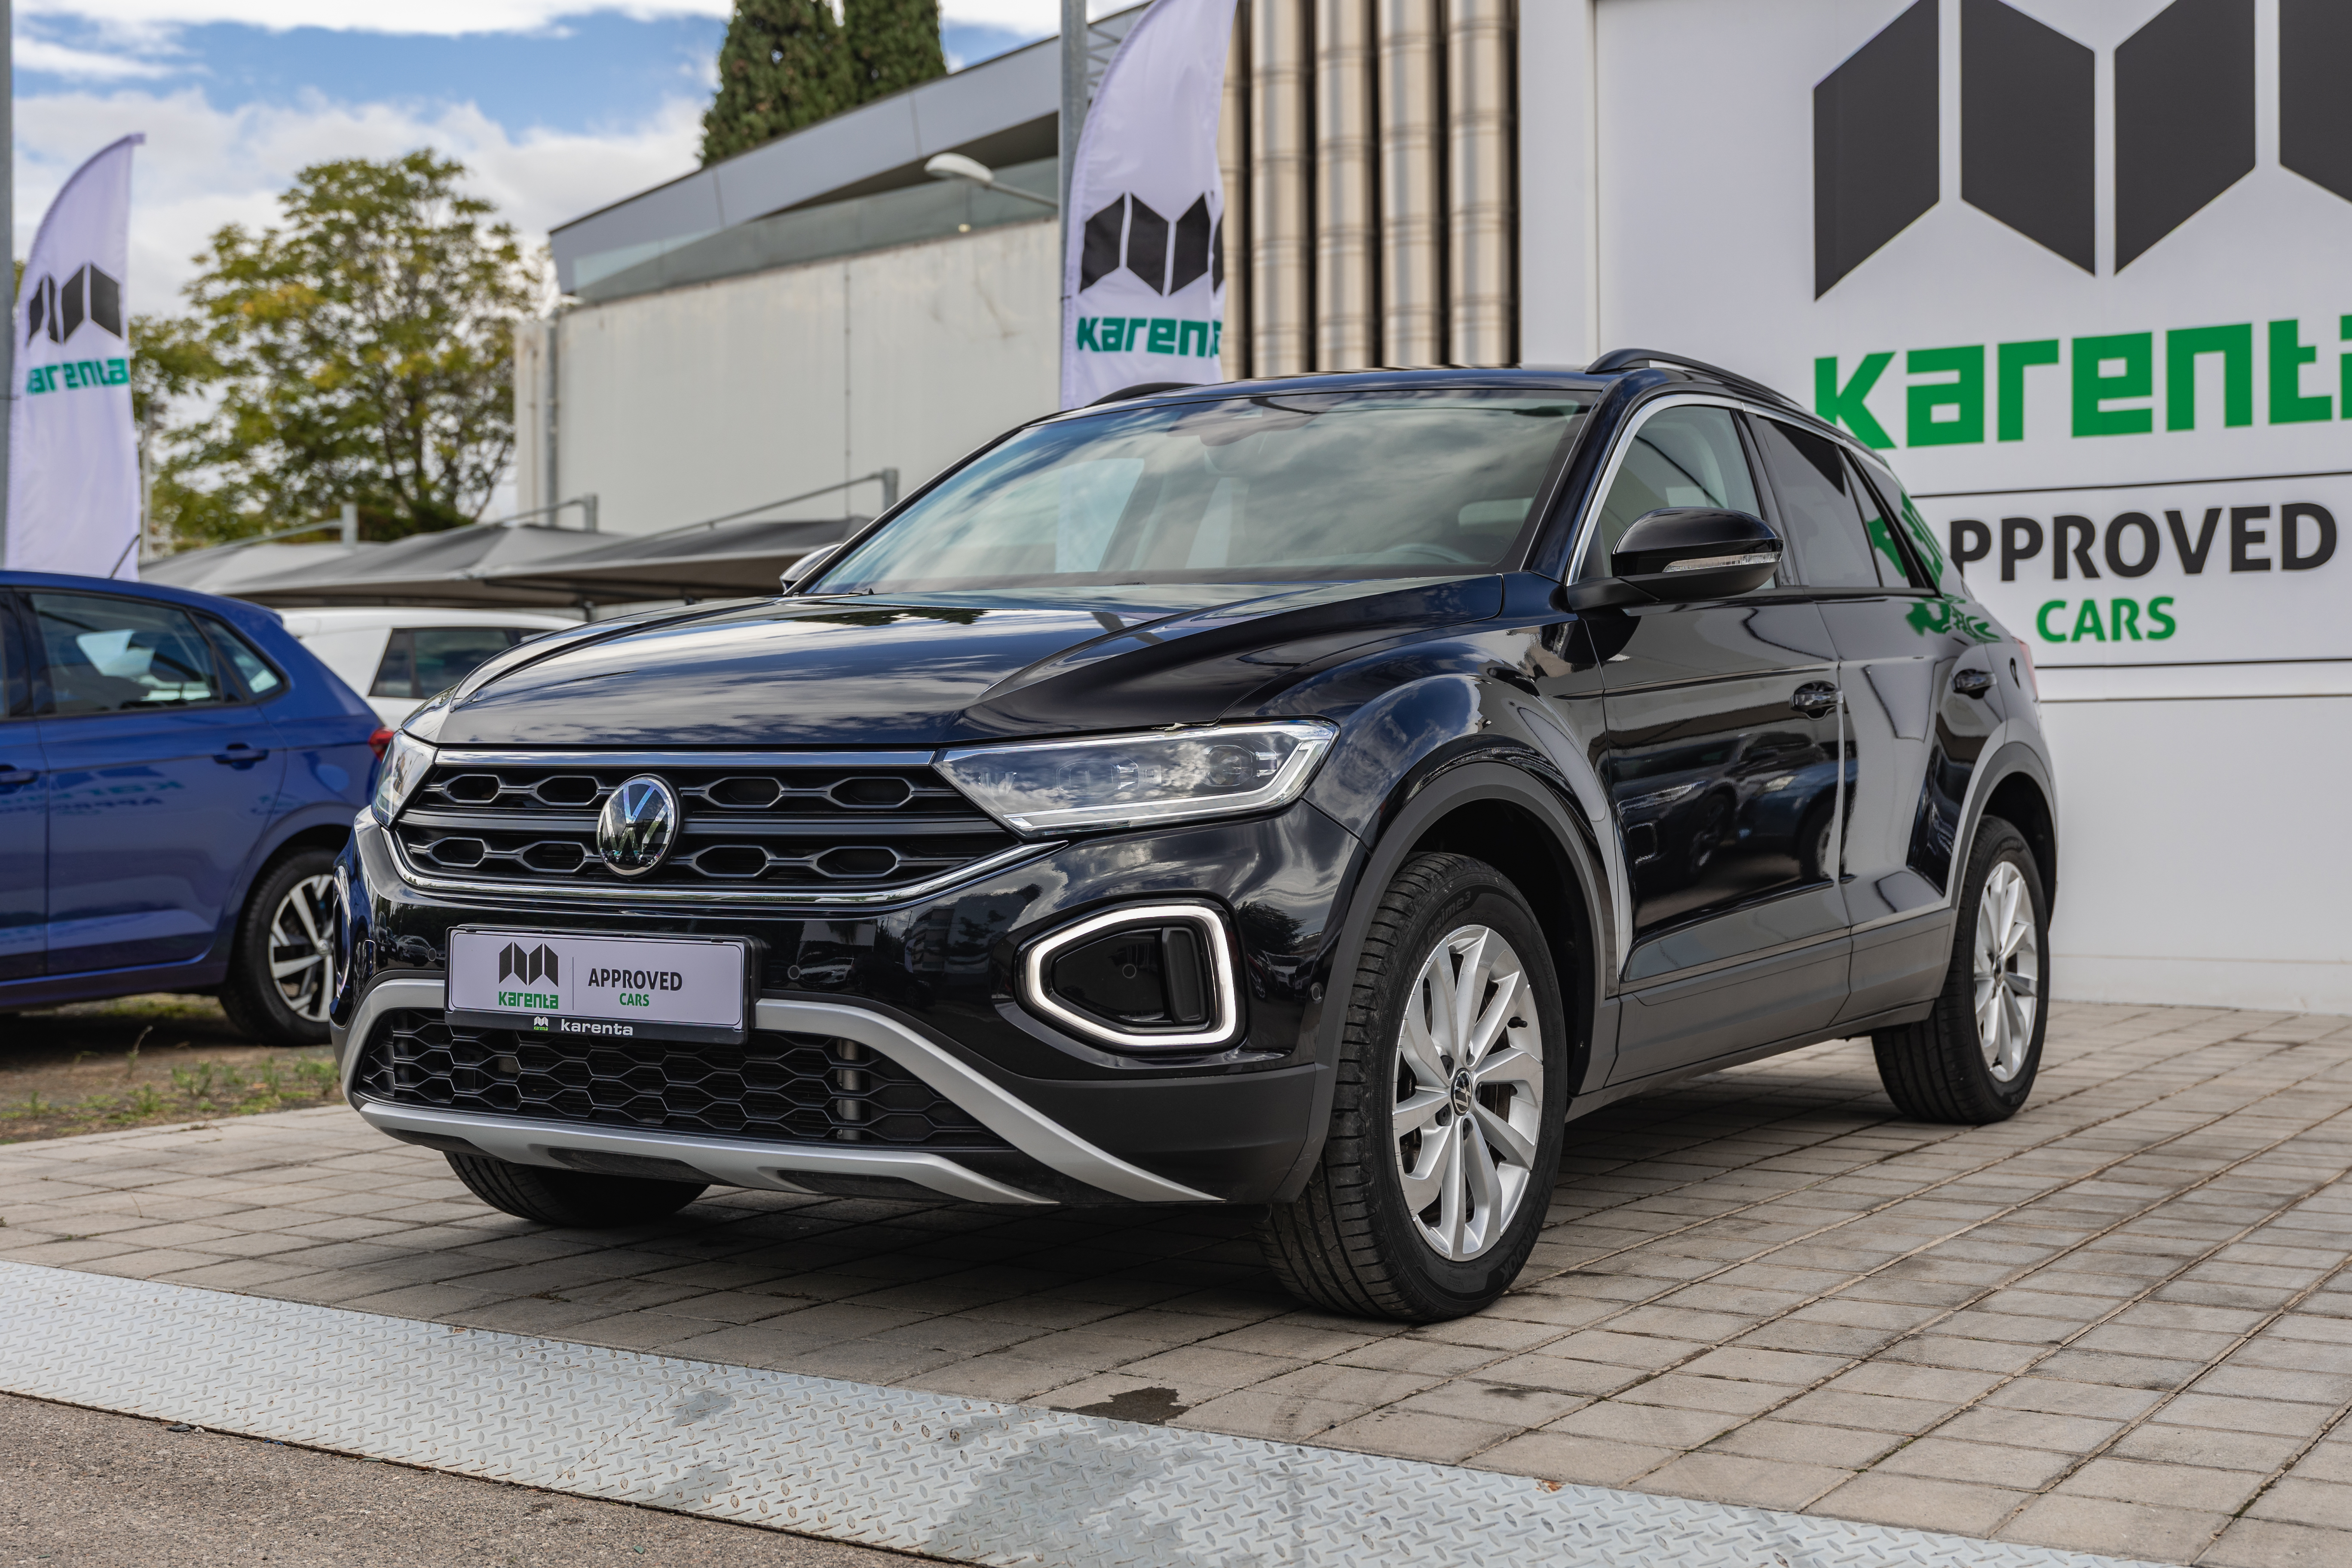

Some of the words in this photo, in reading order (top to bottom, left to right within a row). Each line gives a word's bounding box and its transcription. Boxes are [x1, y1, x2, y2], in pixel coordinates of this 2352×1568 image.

[27, 358, 129, 393] arenta
[1950, 502, 2338, 582] PPROVED
[2036, 596, 2177, 642] CARS
[588, 968, 683, 991] APPROVED
[1537, 943, 1556, 996] OUTSIDE
[619, 993, 649, 1007] CARS
[561, 1019, 633, 1036] karenta
